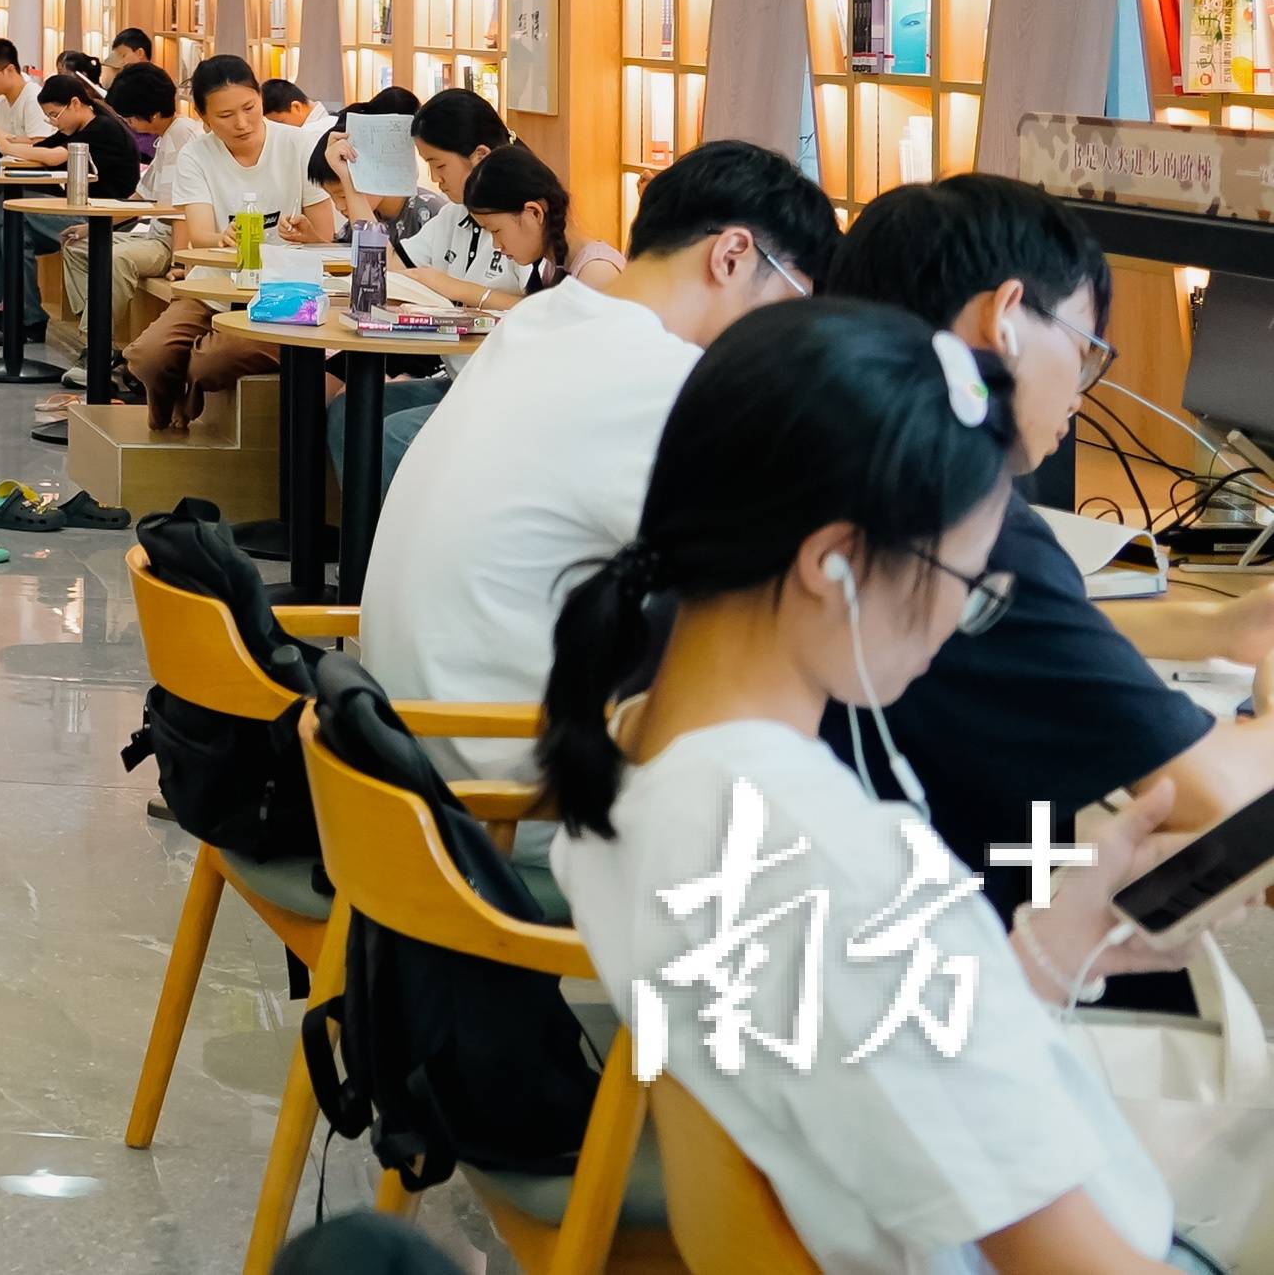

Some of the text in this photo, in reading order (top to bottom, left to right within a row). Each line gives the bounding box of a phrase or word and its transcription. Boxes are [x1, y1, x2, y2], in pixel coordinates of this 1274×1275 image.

[1073, 142, 1212, 183] 书是人类进步的阶梯
